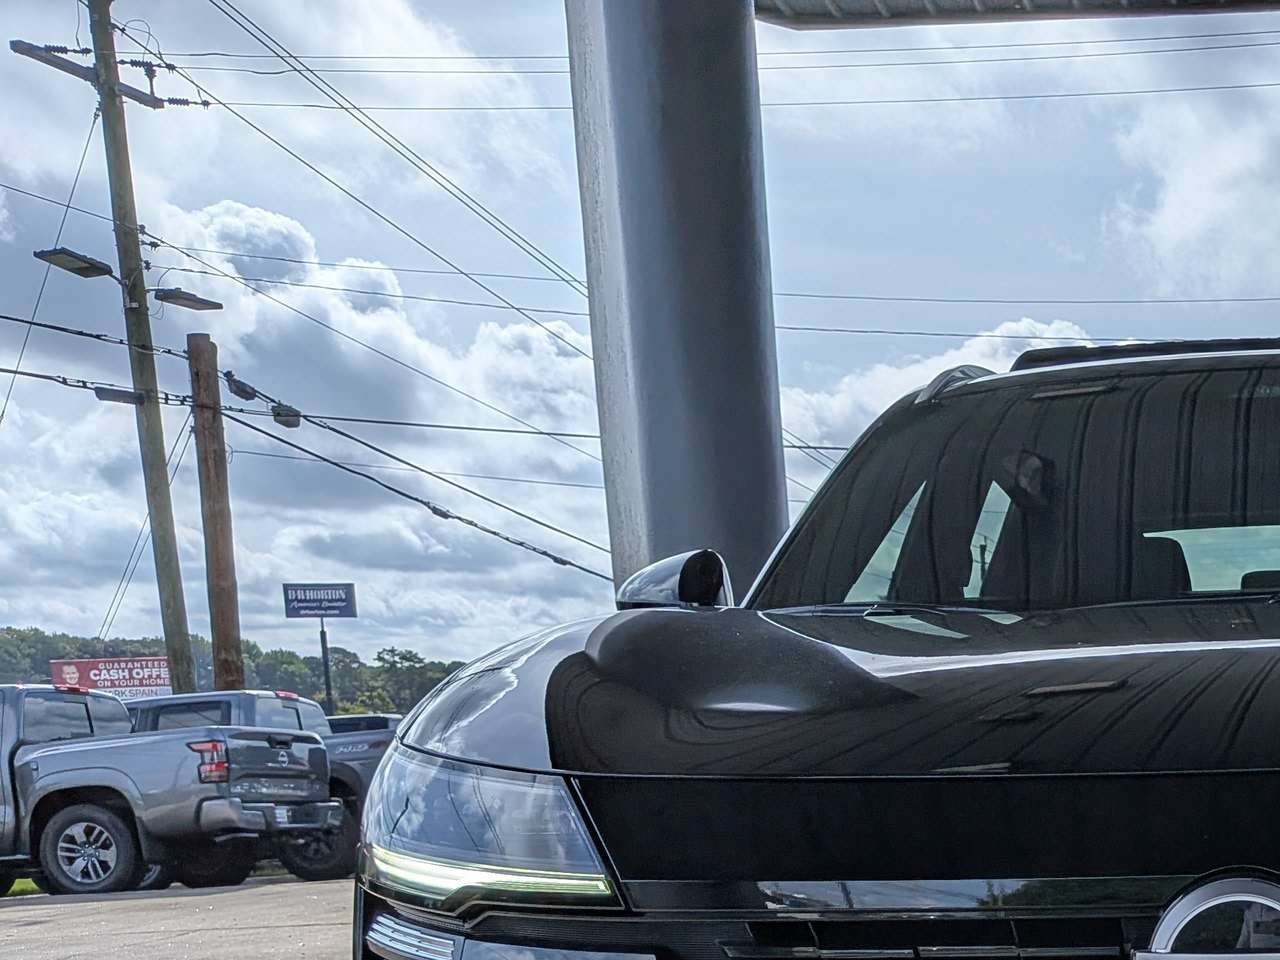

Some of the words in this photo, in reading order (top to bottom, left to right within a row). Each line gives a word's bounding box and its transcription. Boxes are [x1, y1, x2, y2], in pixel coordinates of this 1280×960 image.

[89, 669, 130, 680] CASH
[132, 668, 169, 679] OFFE
[114, 679, 140, 687] YOUR
[142, 678, 170, 686] HOME
[129, 688, 157, 697] SPAIN
